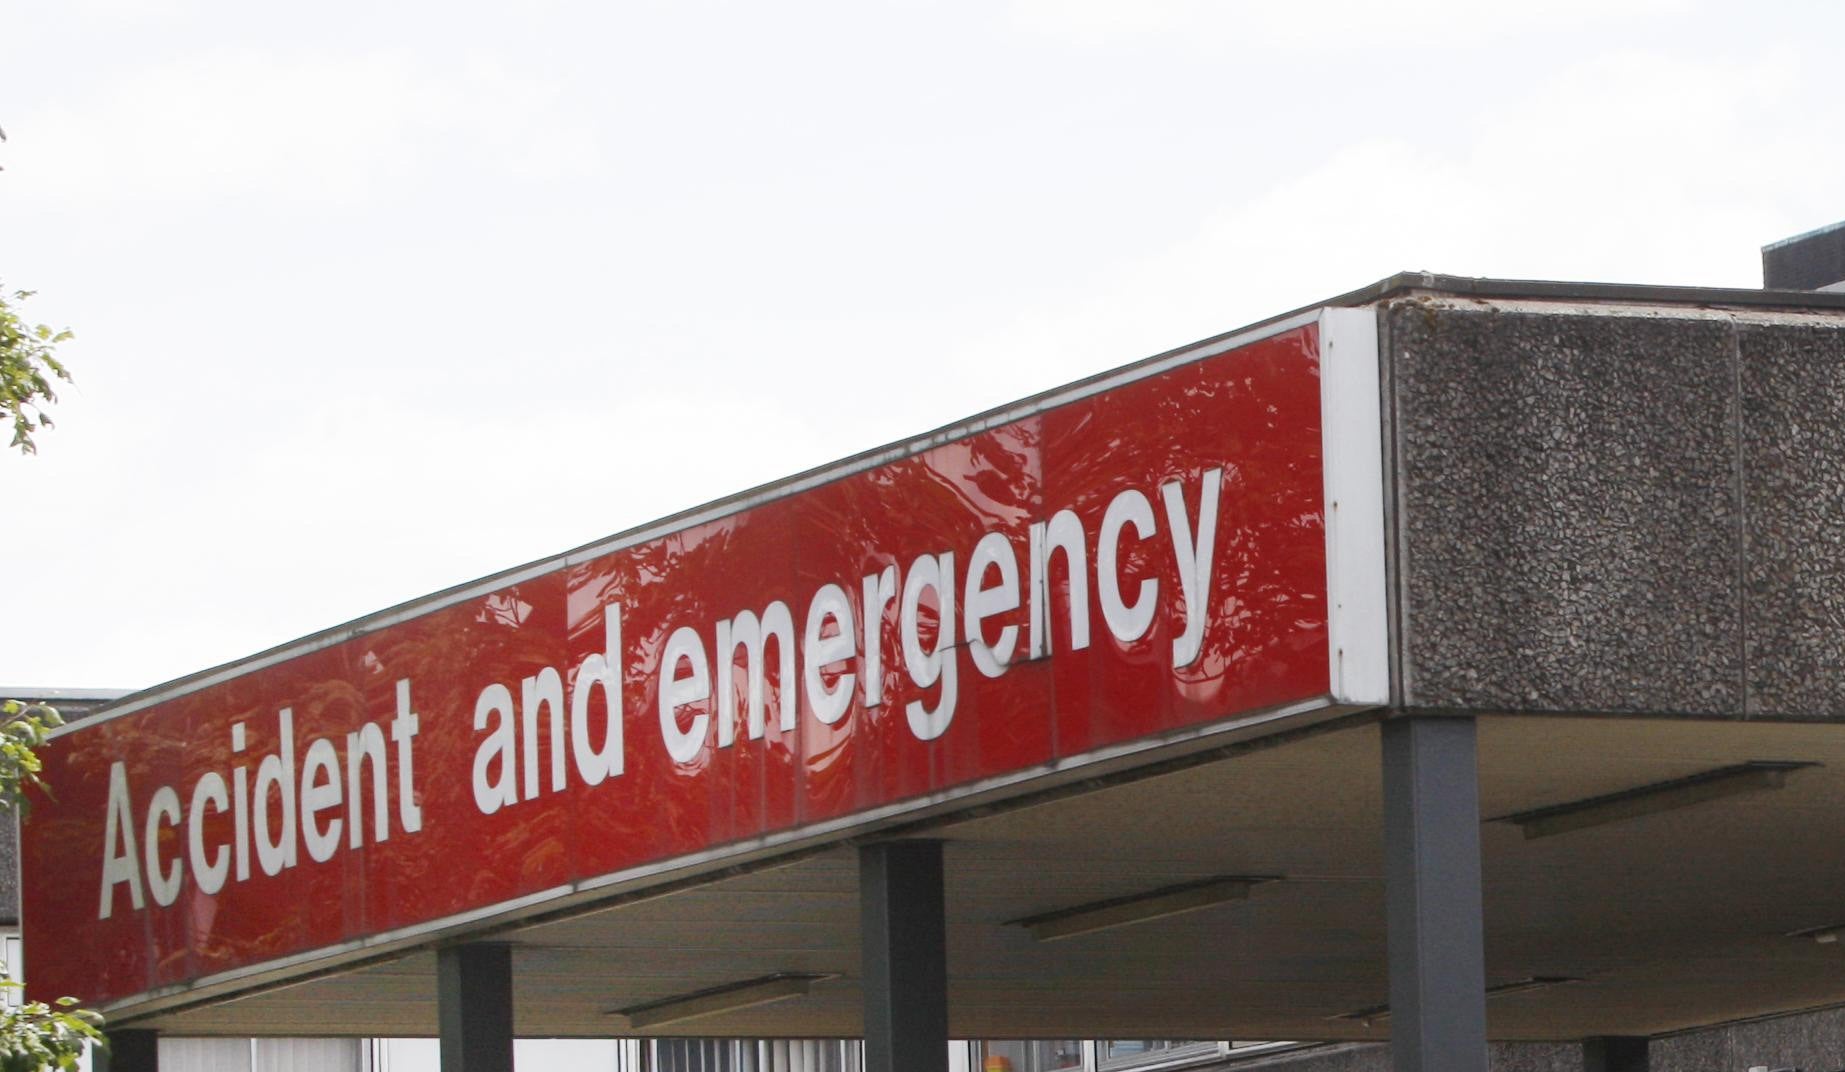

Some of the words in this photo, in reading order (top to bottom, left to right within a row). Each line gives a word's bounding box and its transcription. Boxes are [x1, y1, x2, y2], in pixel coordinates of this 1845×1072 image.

[99, 678, 423, 920] Accident
[472, 602, 626, 817] and
[659, 467, 1223, 764] emergency
